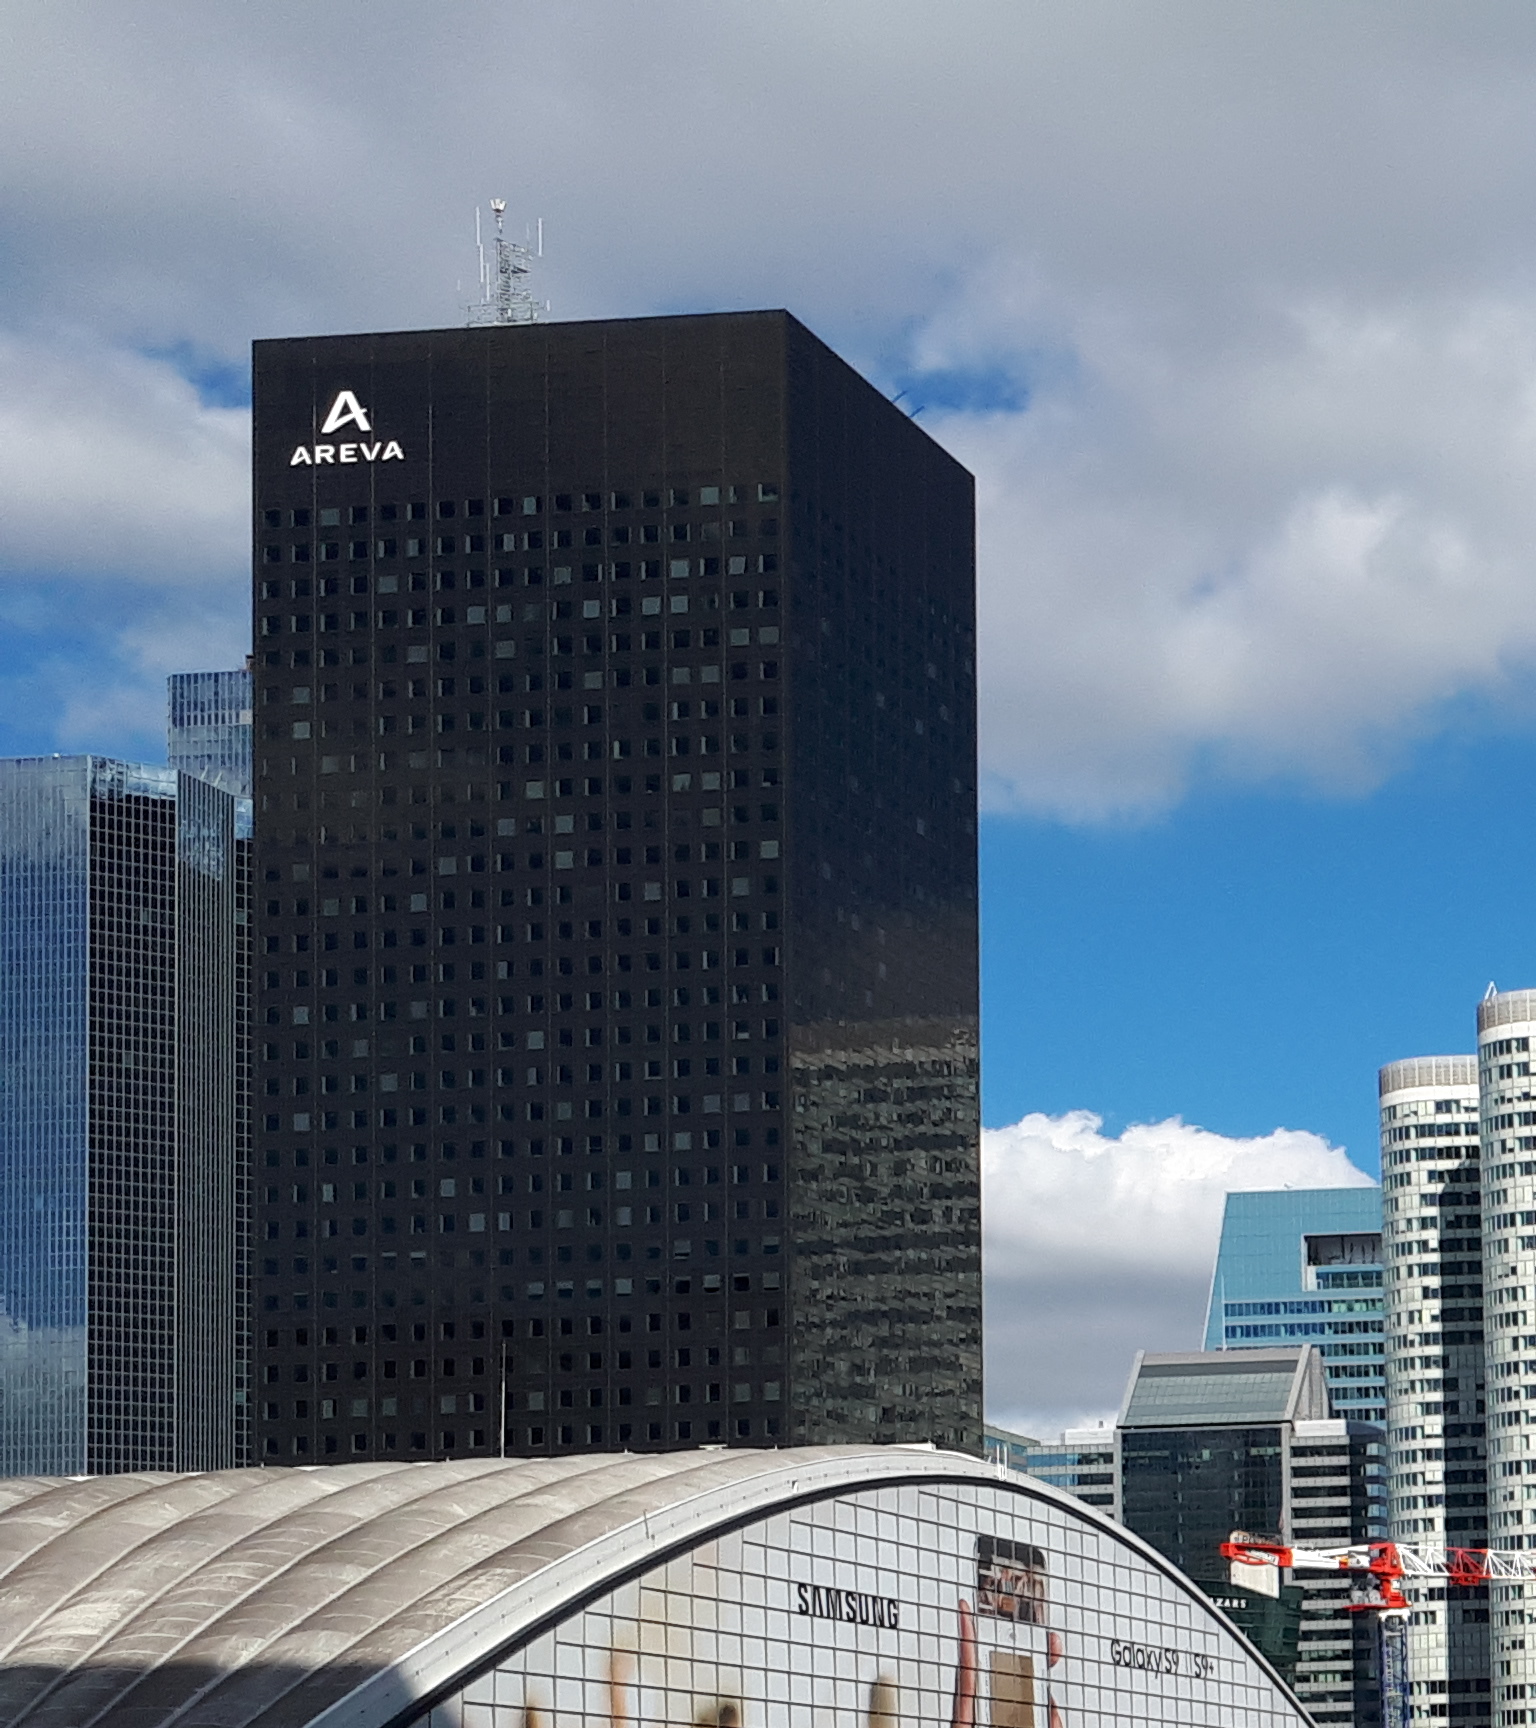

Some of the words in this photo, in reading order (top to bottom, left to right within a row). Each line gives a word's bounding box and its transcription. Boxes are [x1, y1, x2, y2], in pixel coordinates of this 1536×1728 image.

[289, 440, 405, 467] AREVA
[797, 1582, 899, 1629] SAMSUNG
[1208, 1597, 1247, 1609] AZARS
[1110, 1638, 1162, 1680] Galaxy
[1164, 1647, 1179, 1674] S9
[1193, 1652, 1215, 1679] S9+
